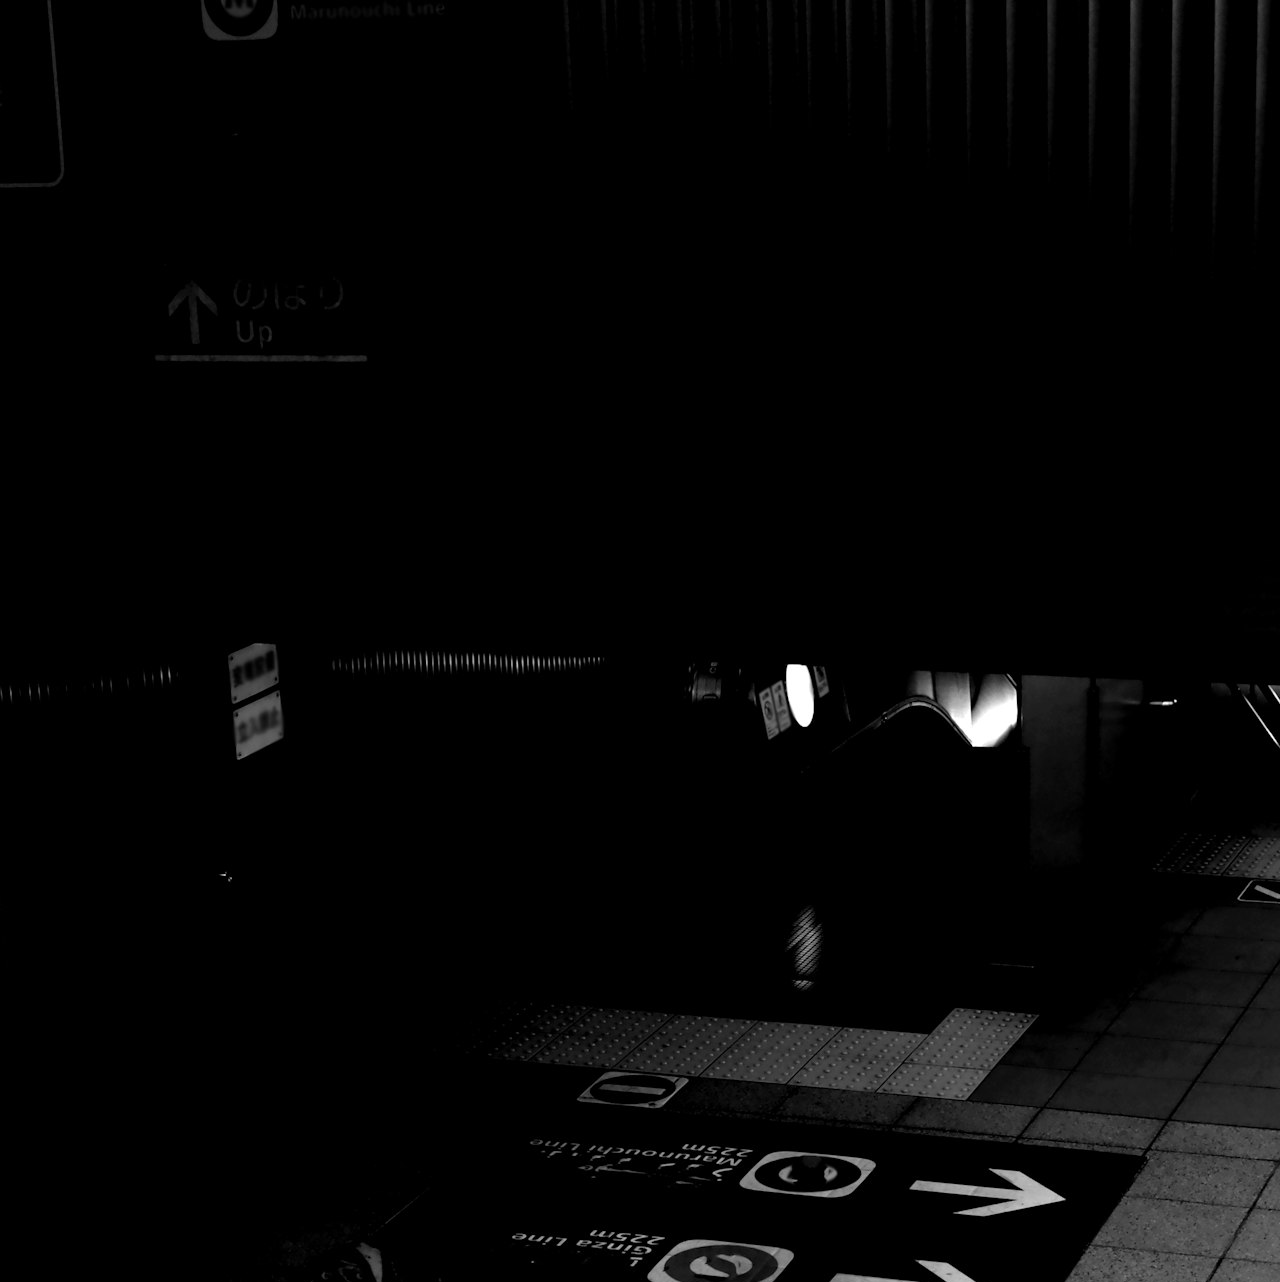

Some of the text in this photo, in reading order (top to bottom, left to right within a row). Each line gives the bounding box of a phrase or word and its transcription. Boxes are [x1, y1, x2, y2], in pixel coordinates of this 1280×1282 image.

[290, 1, 446, 21] Marunouchi Line
[234, 319, 273, 350] Up
[529, 1138, 743, 1167] Marunouchi Line
[680, 1142, 754, 1159] 225m
[511, 1232, 653, 1255] Ginza Line
[588, 1228, 666, 1245] 225m
